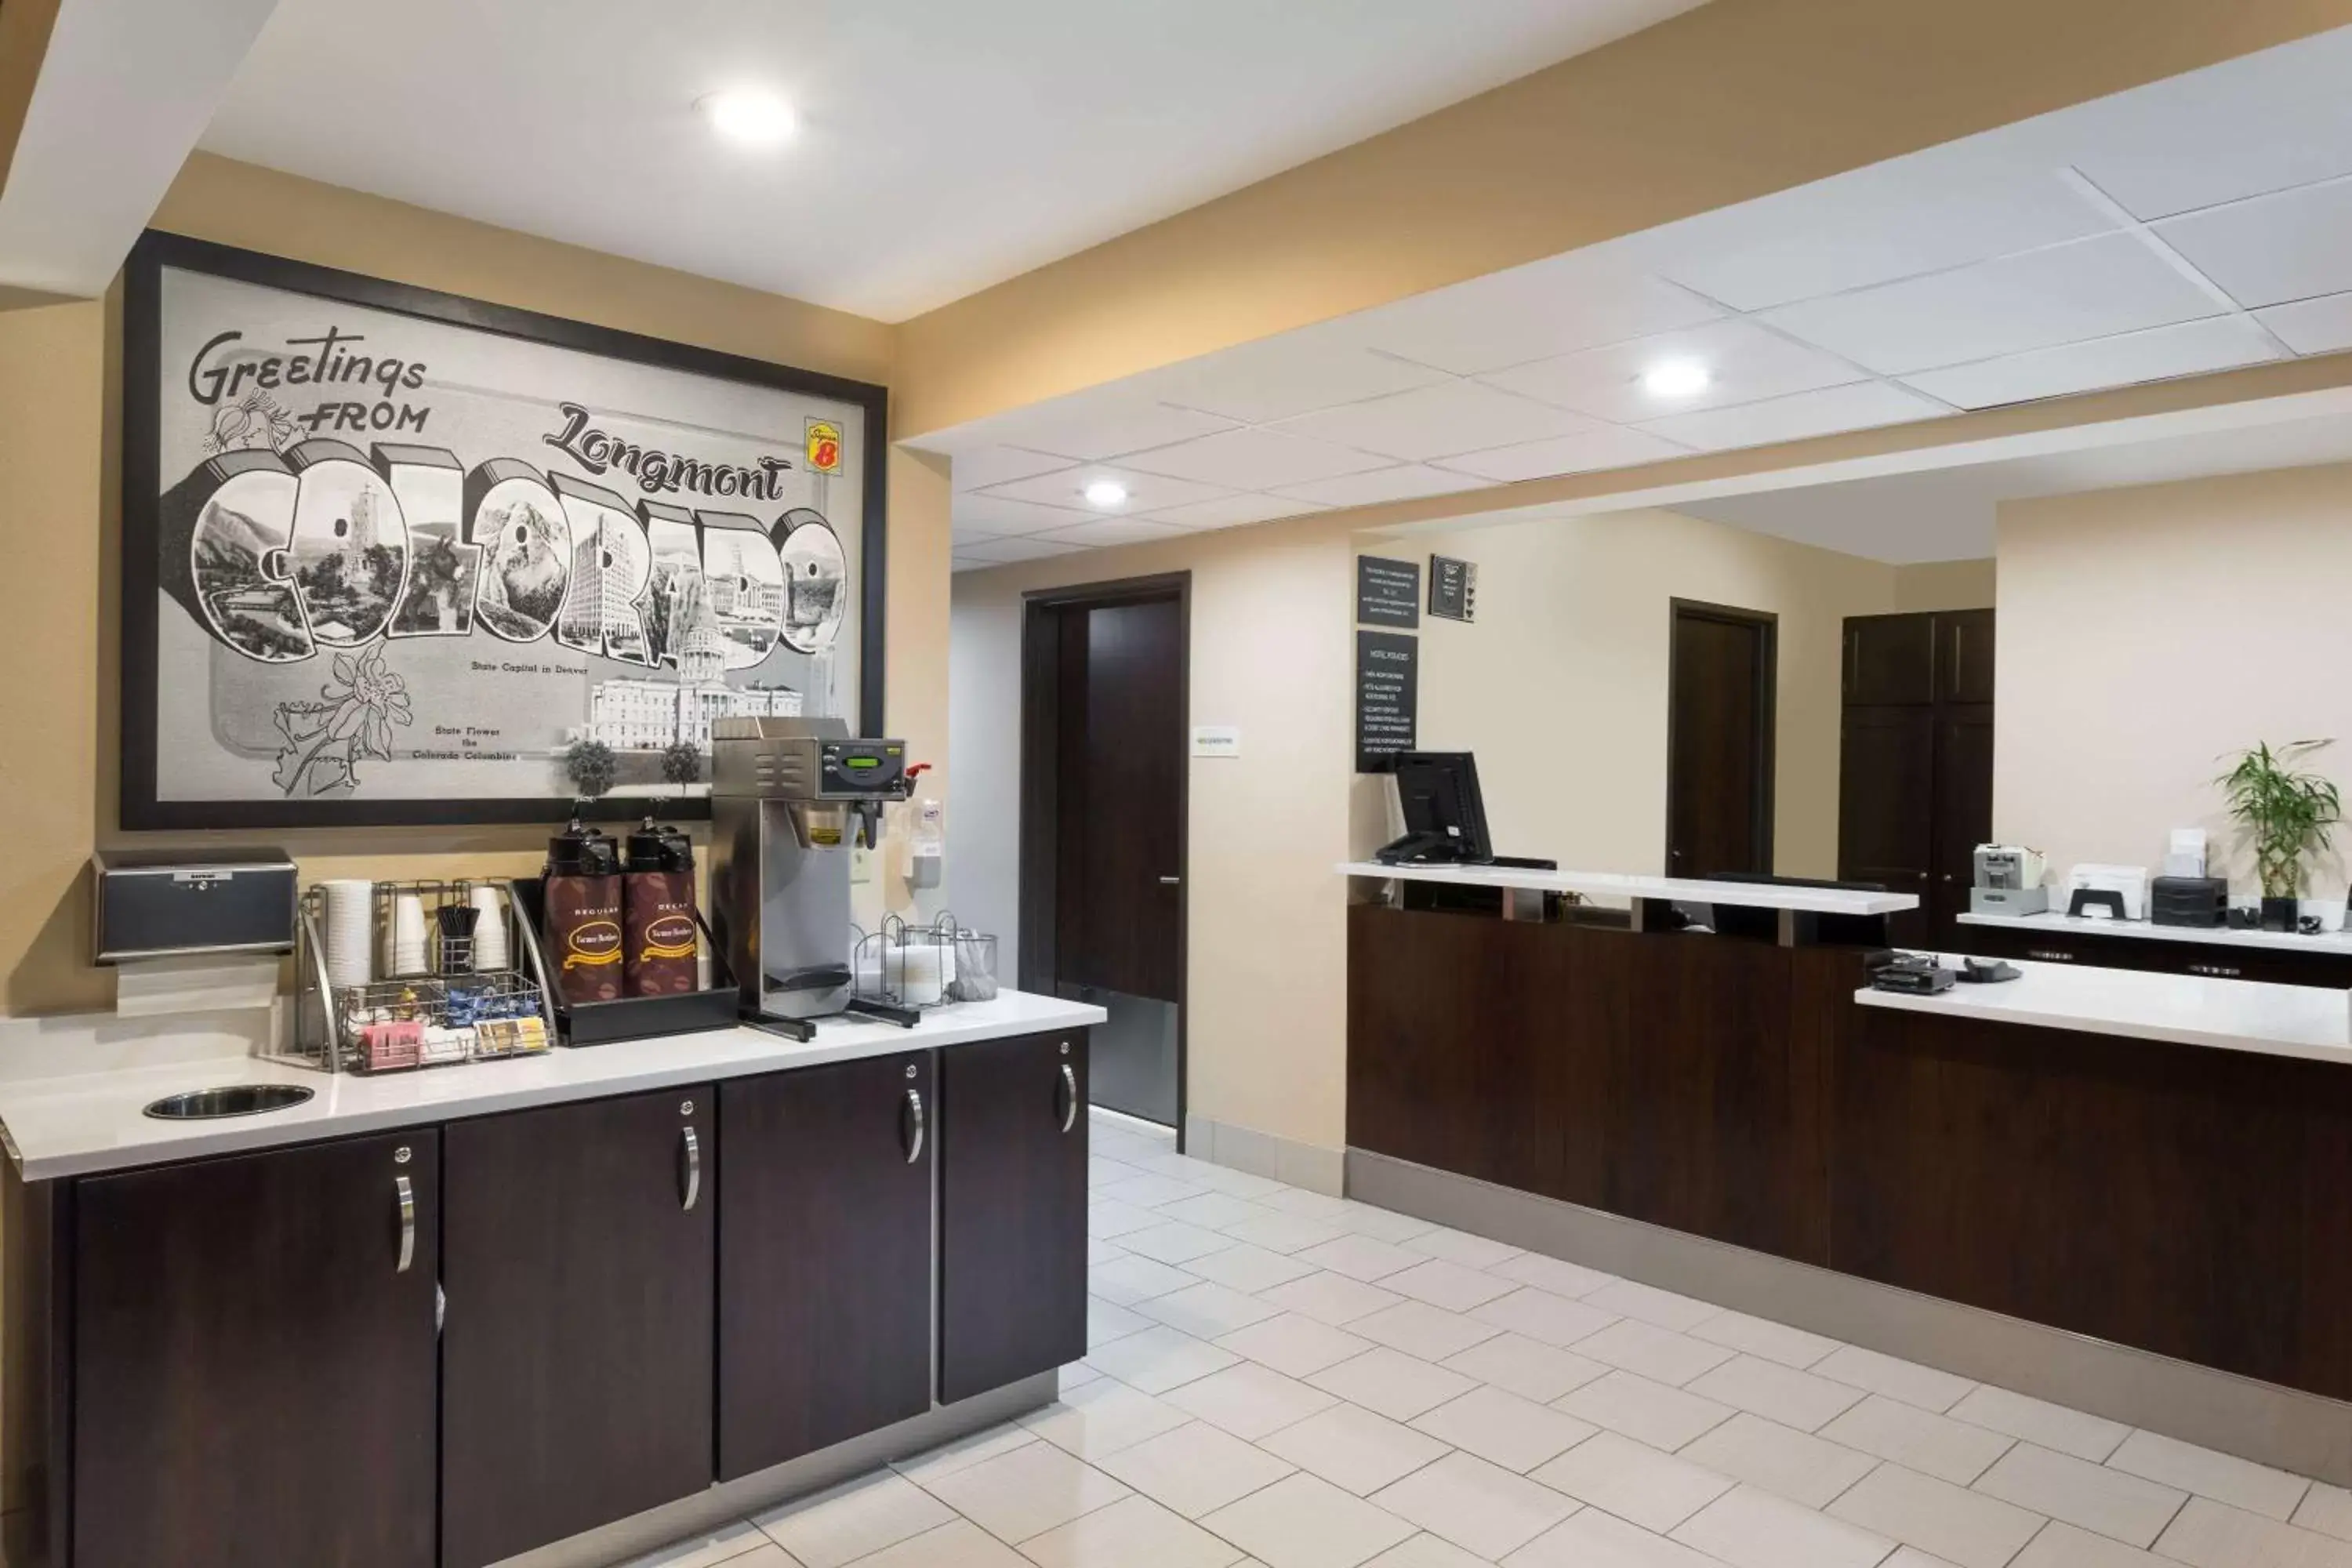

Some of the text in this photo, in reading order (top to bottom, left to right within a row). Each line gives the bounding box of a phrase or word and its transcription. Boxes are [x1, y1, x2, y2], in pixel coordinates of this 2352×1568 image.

[189, 325, 427, 405] Greetings
[297, 401, 431, 434] FROM
[542, 401, 792, 500] Longmont
[815, 441, 837, 468] 8
[185, 443, 848, 670] COLORADO
[471, 661, 496, 670] State
[542, 664, 551, 673] in
[555, 665, 588, 674] Denver
[435, 726, 500, 735] State Flower
[412, 750, 459, 760] Colorado
[575, 907, 619, 916] REGULAR
